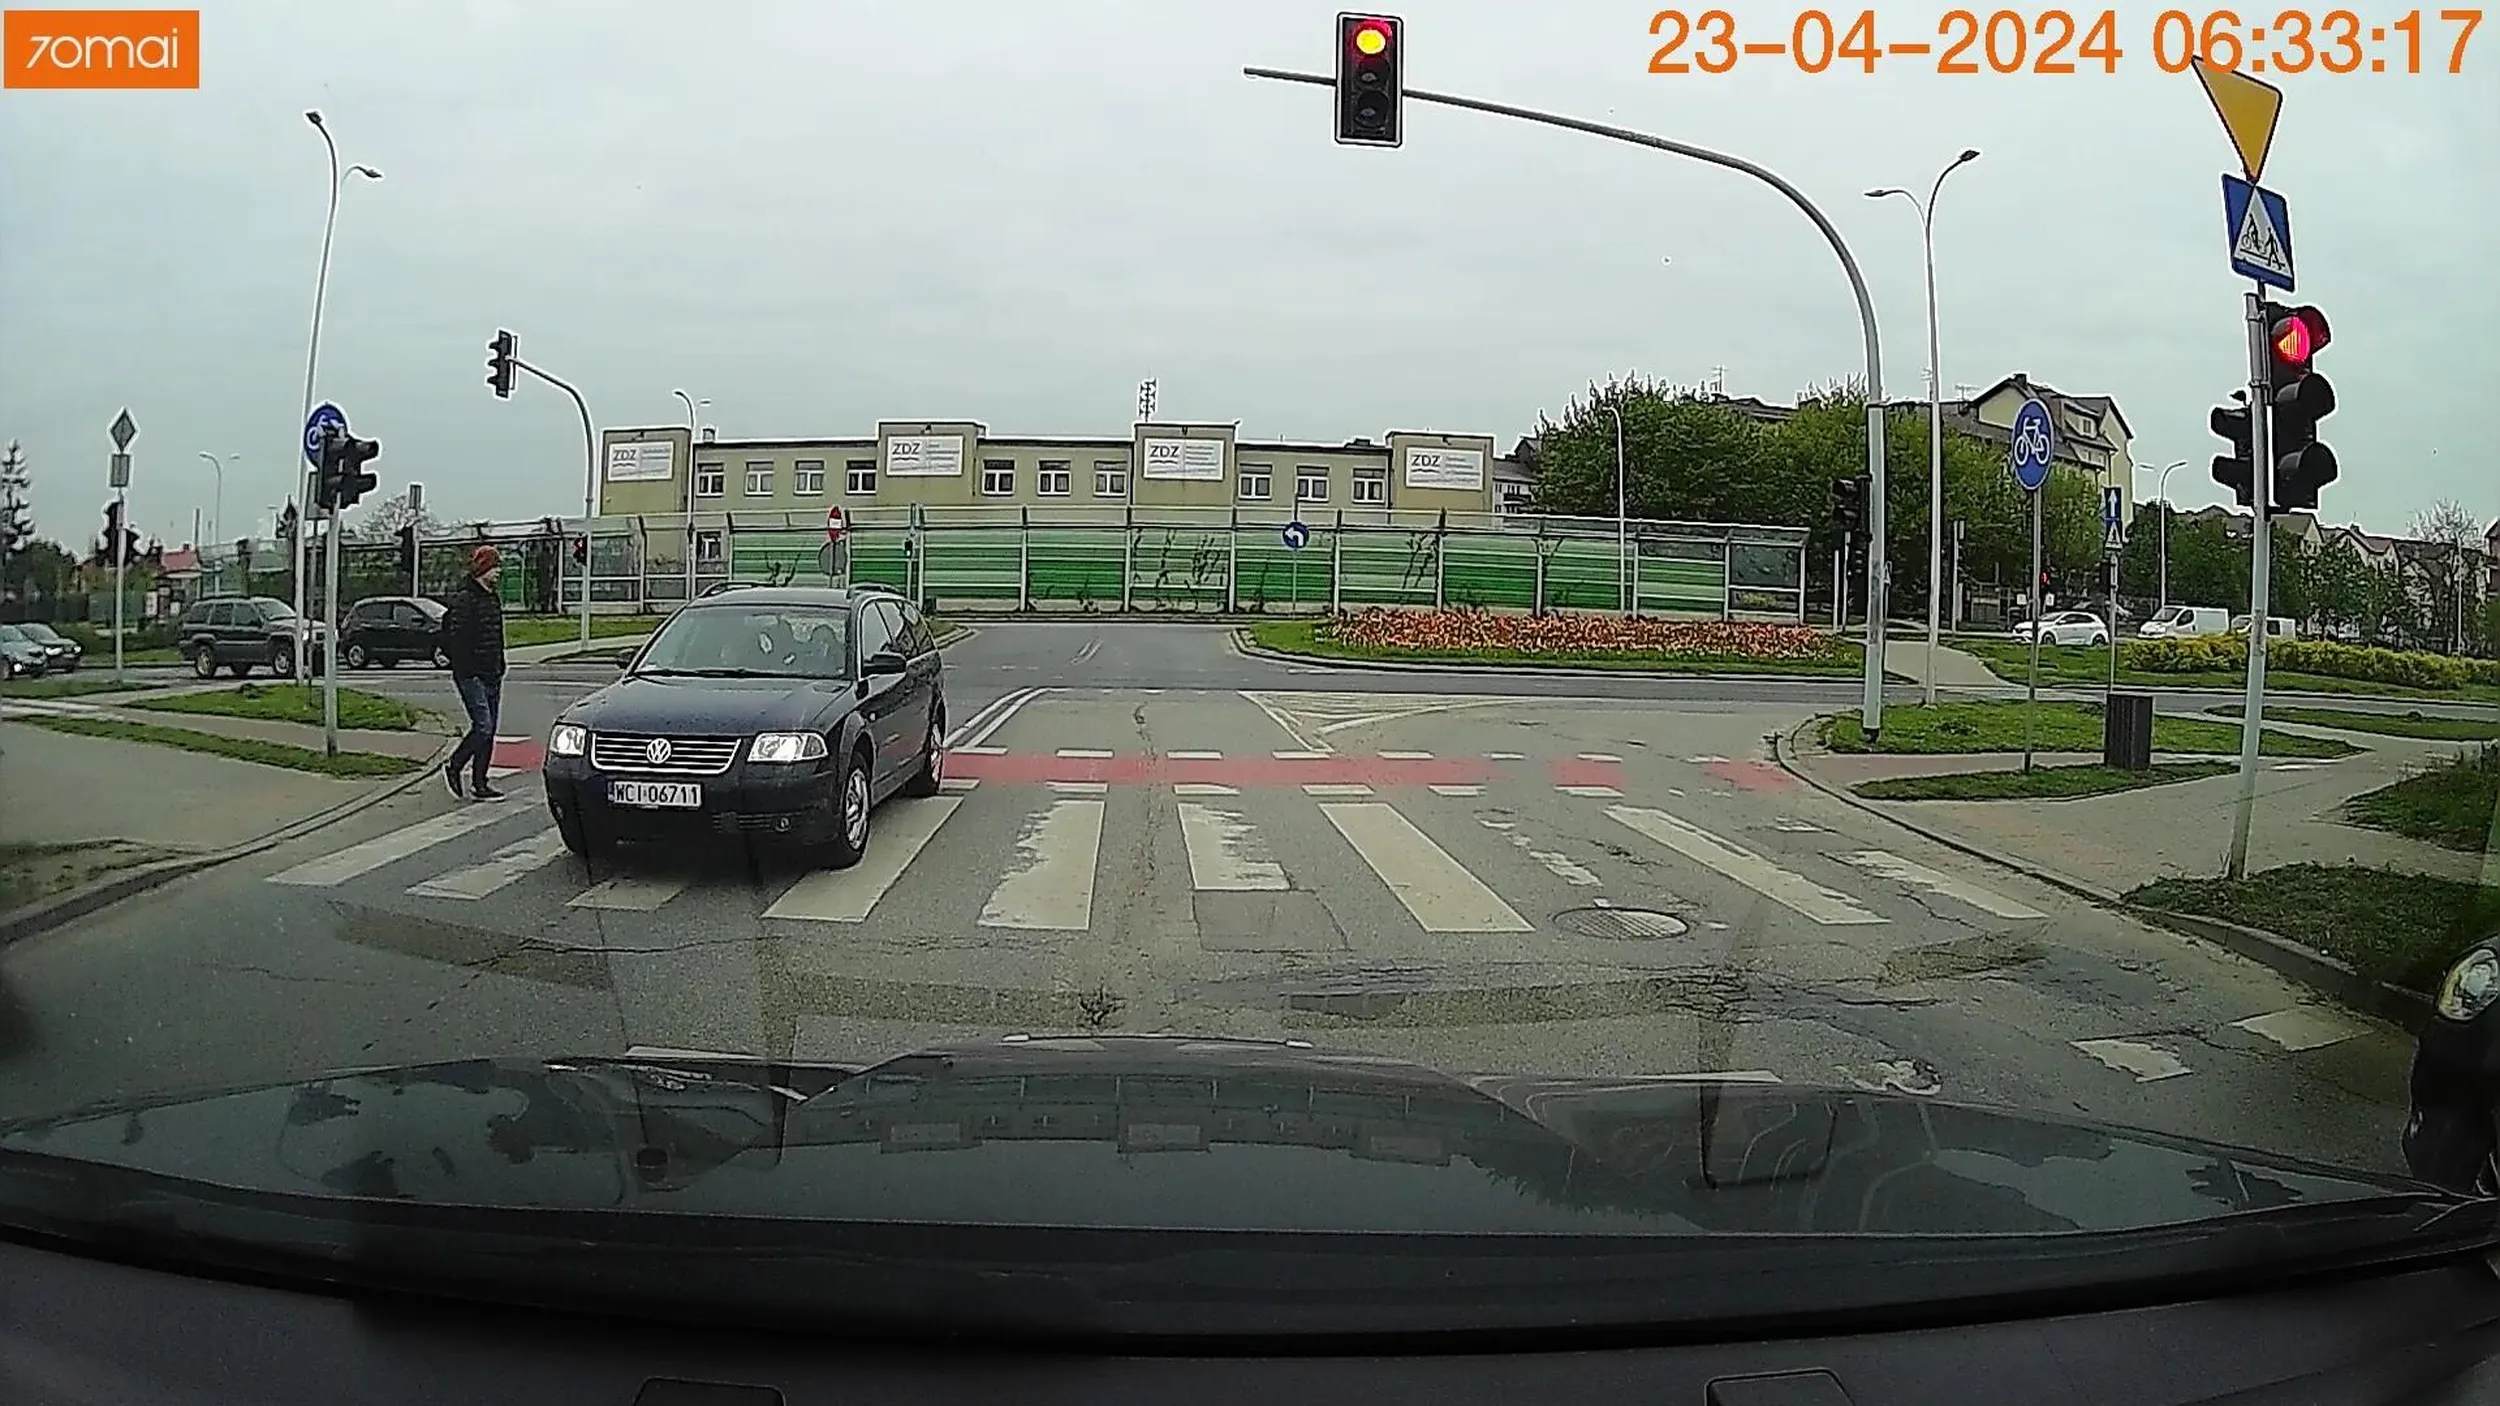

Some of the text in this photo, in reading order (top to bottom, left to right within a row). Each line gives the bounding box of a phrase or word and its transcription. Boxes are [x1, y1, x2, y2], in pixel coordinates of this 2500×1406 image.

[613, 449, 637, 461] ZDZ
[891, 442, 920, 455] ZDZ
[1149, 445, 1180, 458] ZDZ
[1411, 454, 1441, 467] ZDZ
[648, 785, 698, 805] 06711
